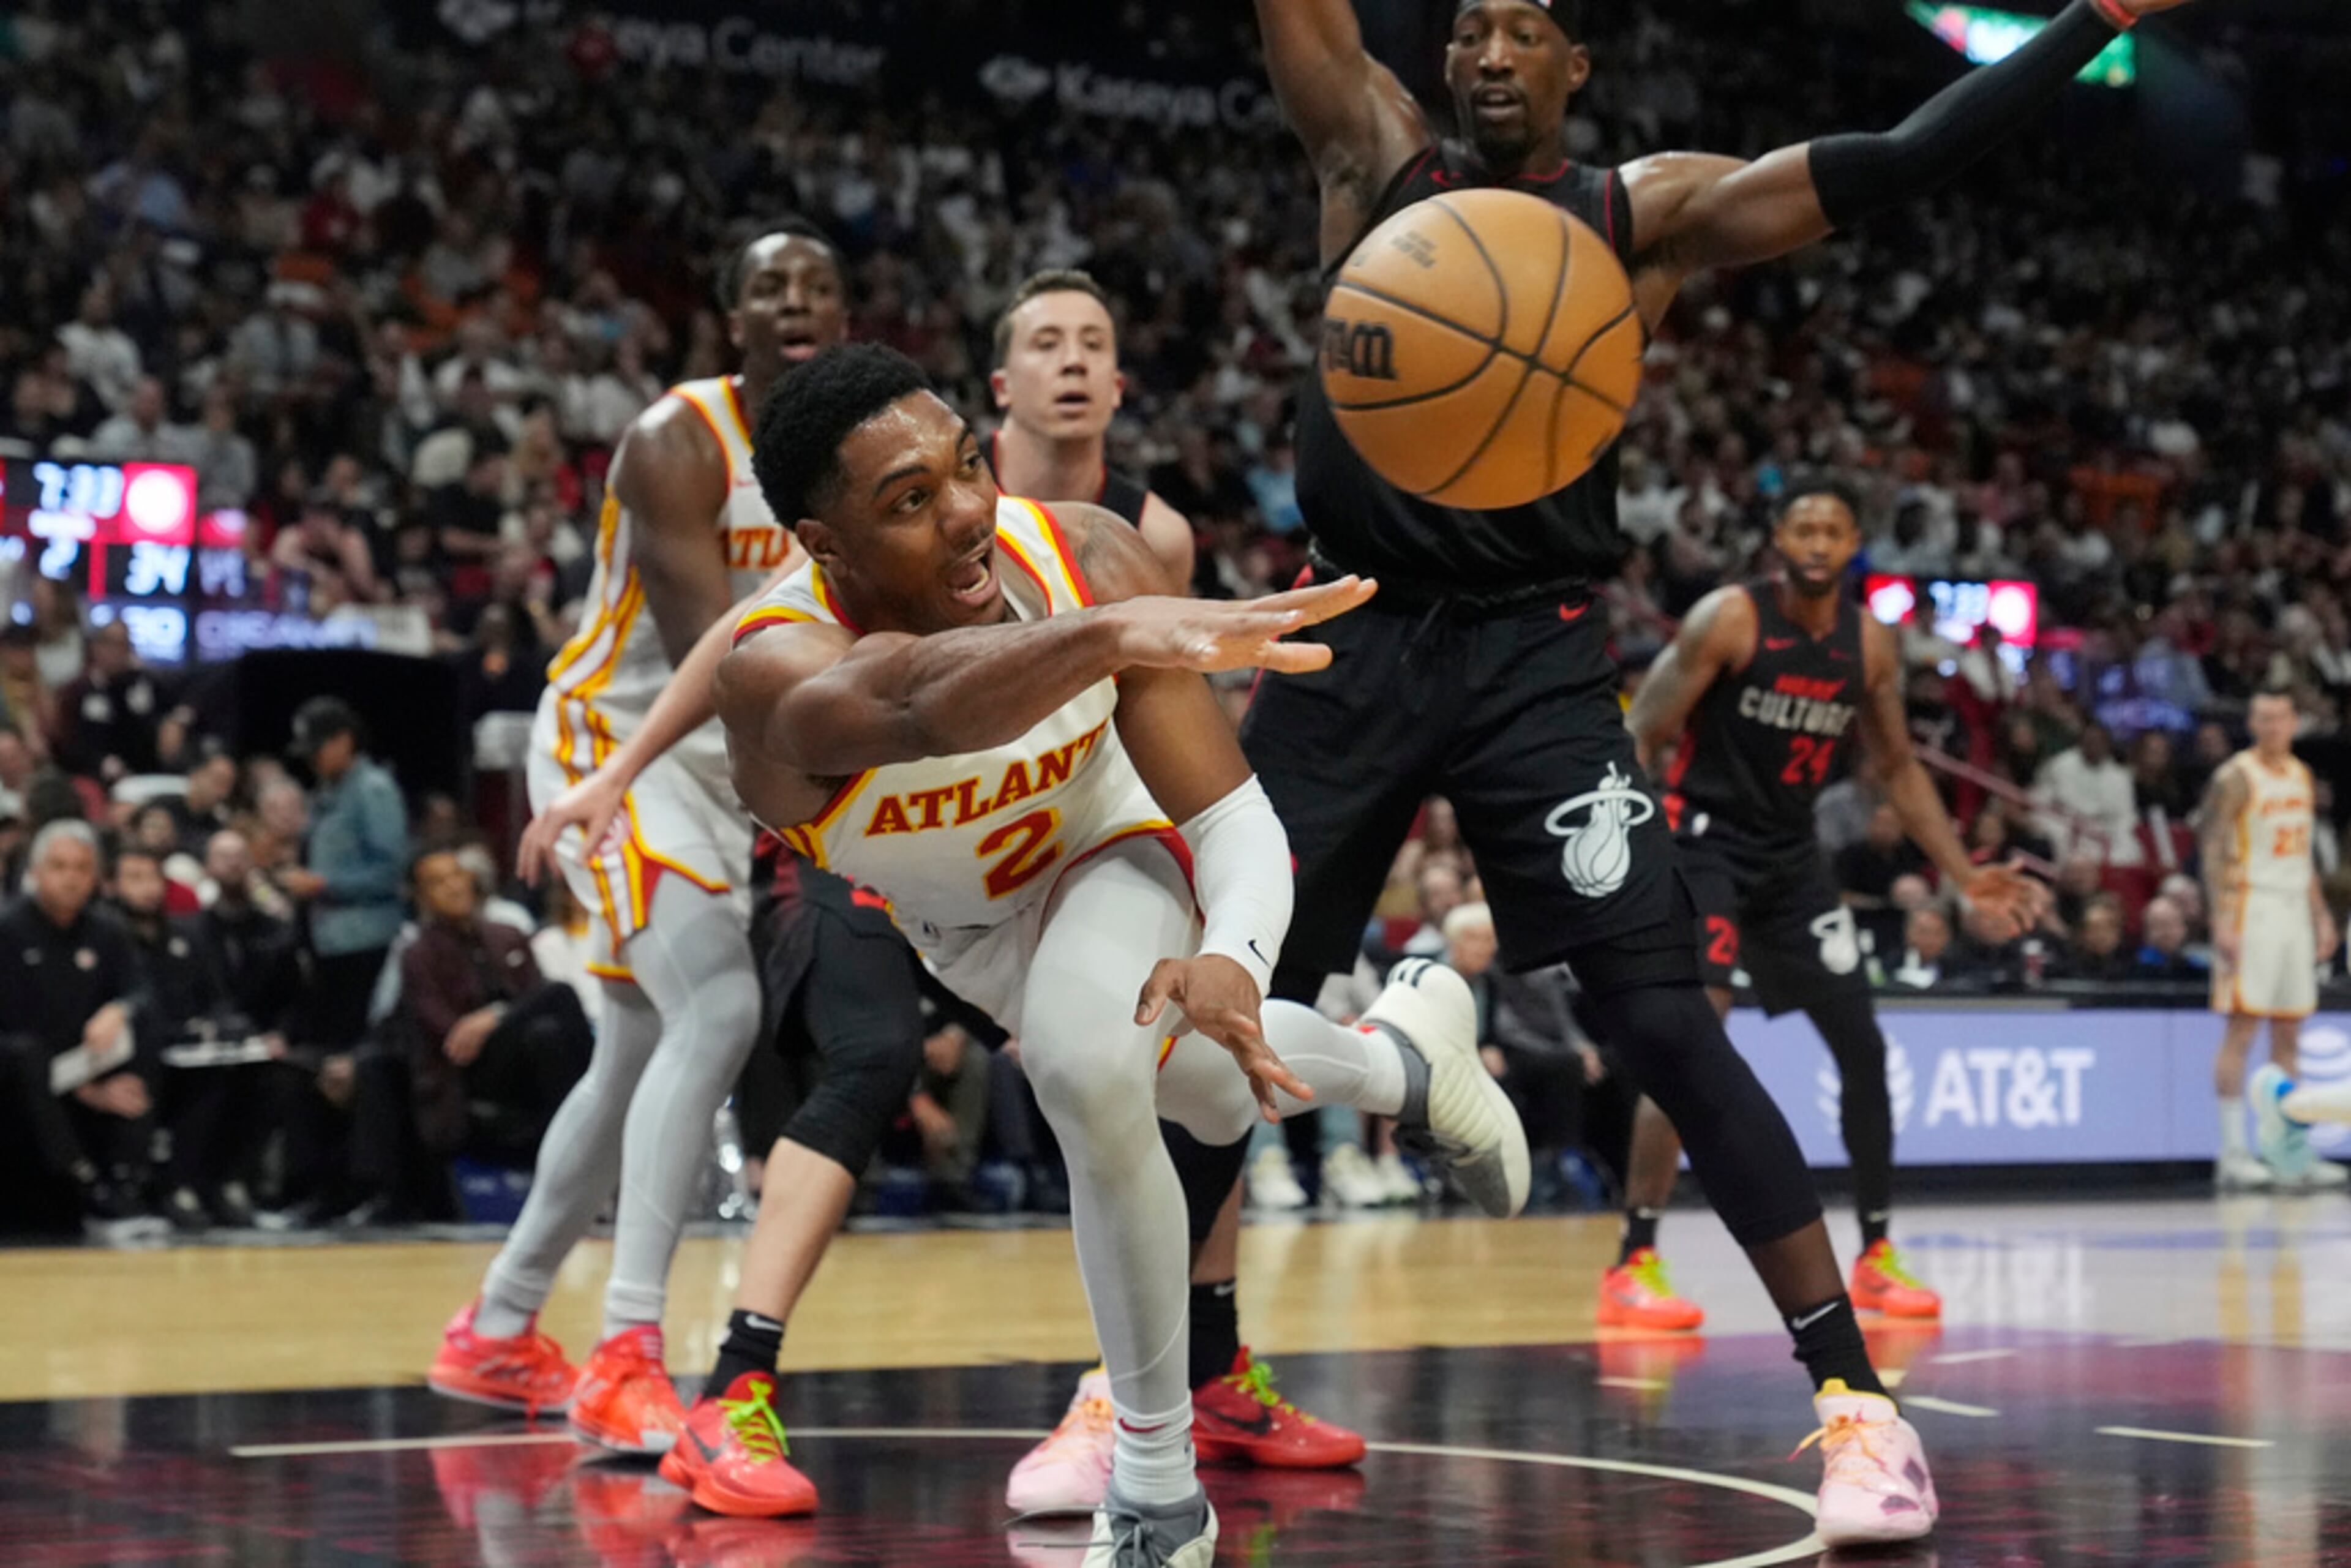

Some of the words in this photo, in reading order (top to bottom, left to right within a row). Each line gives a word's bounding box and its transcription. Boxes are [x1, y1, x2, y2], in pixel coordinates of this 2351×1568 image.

[711, 16, 883, 84] Center
[1054, 61, 1217, 141] Kaseya
[1780, 736, 1835, 785] 24
[974, 806, 1064, 901] 2
[1924, 1045, 2097, 1130] AT&T
